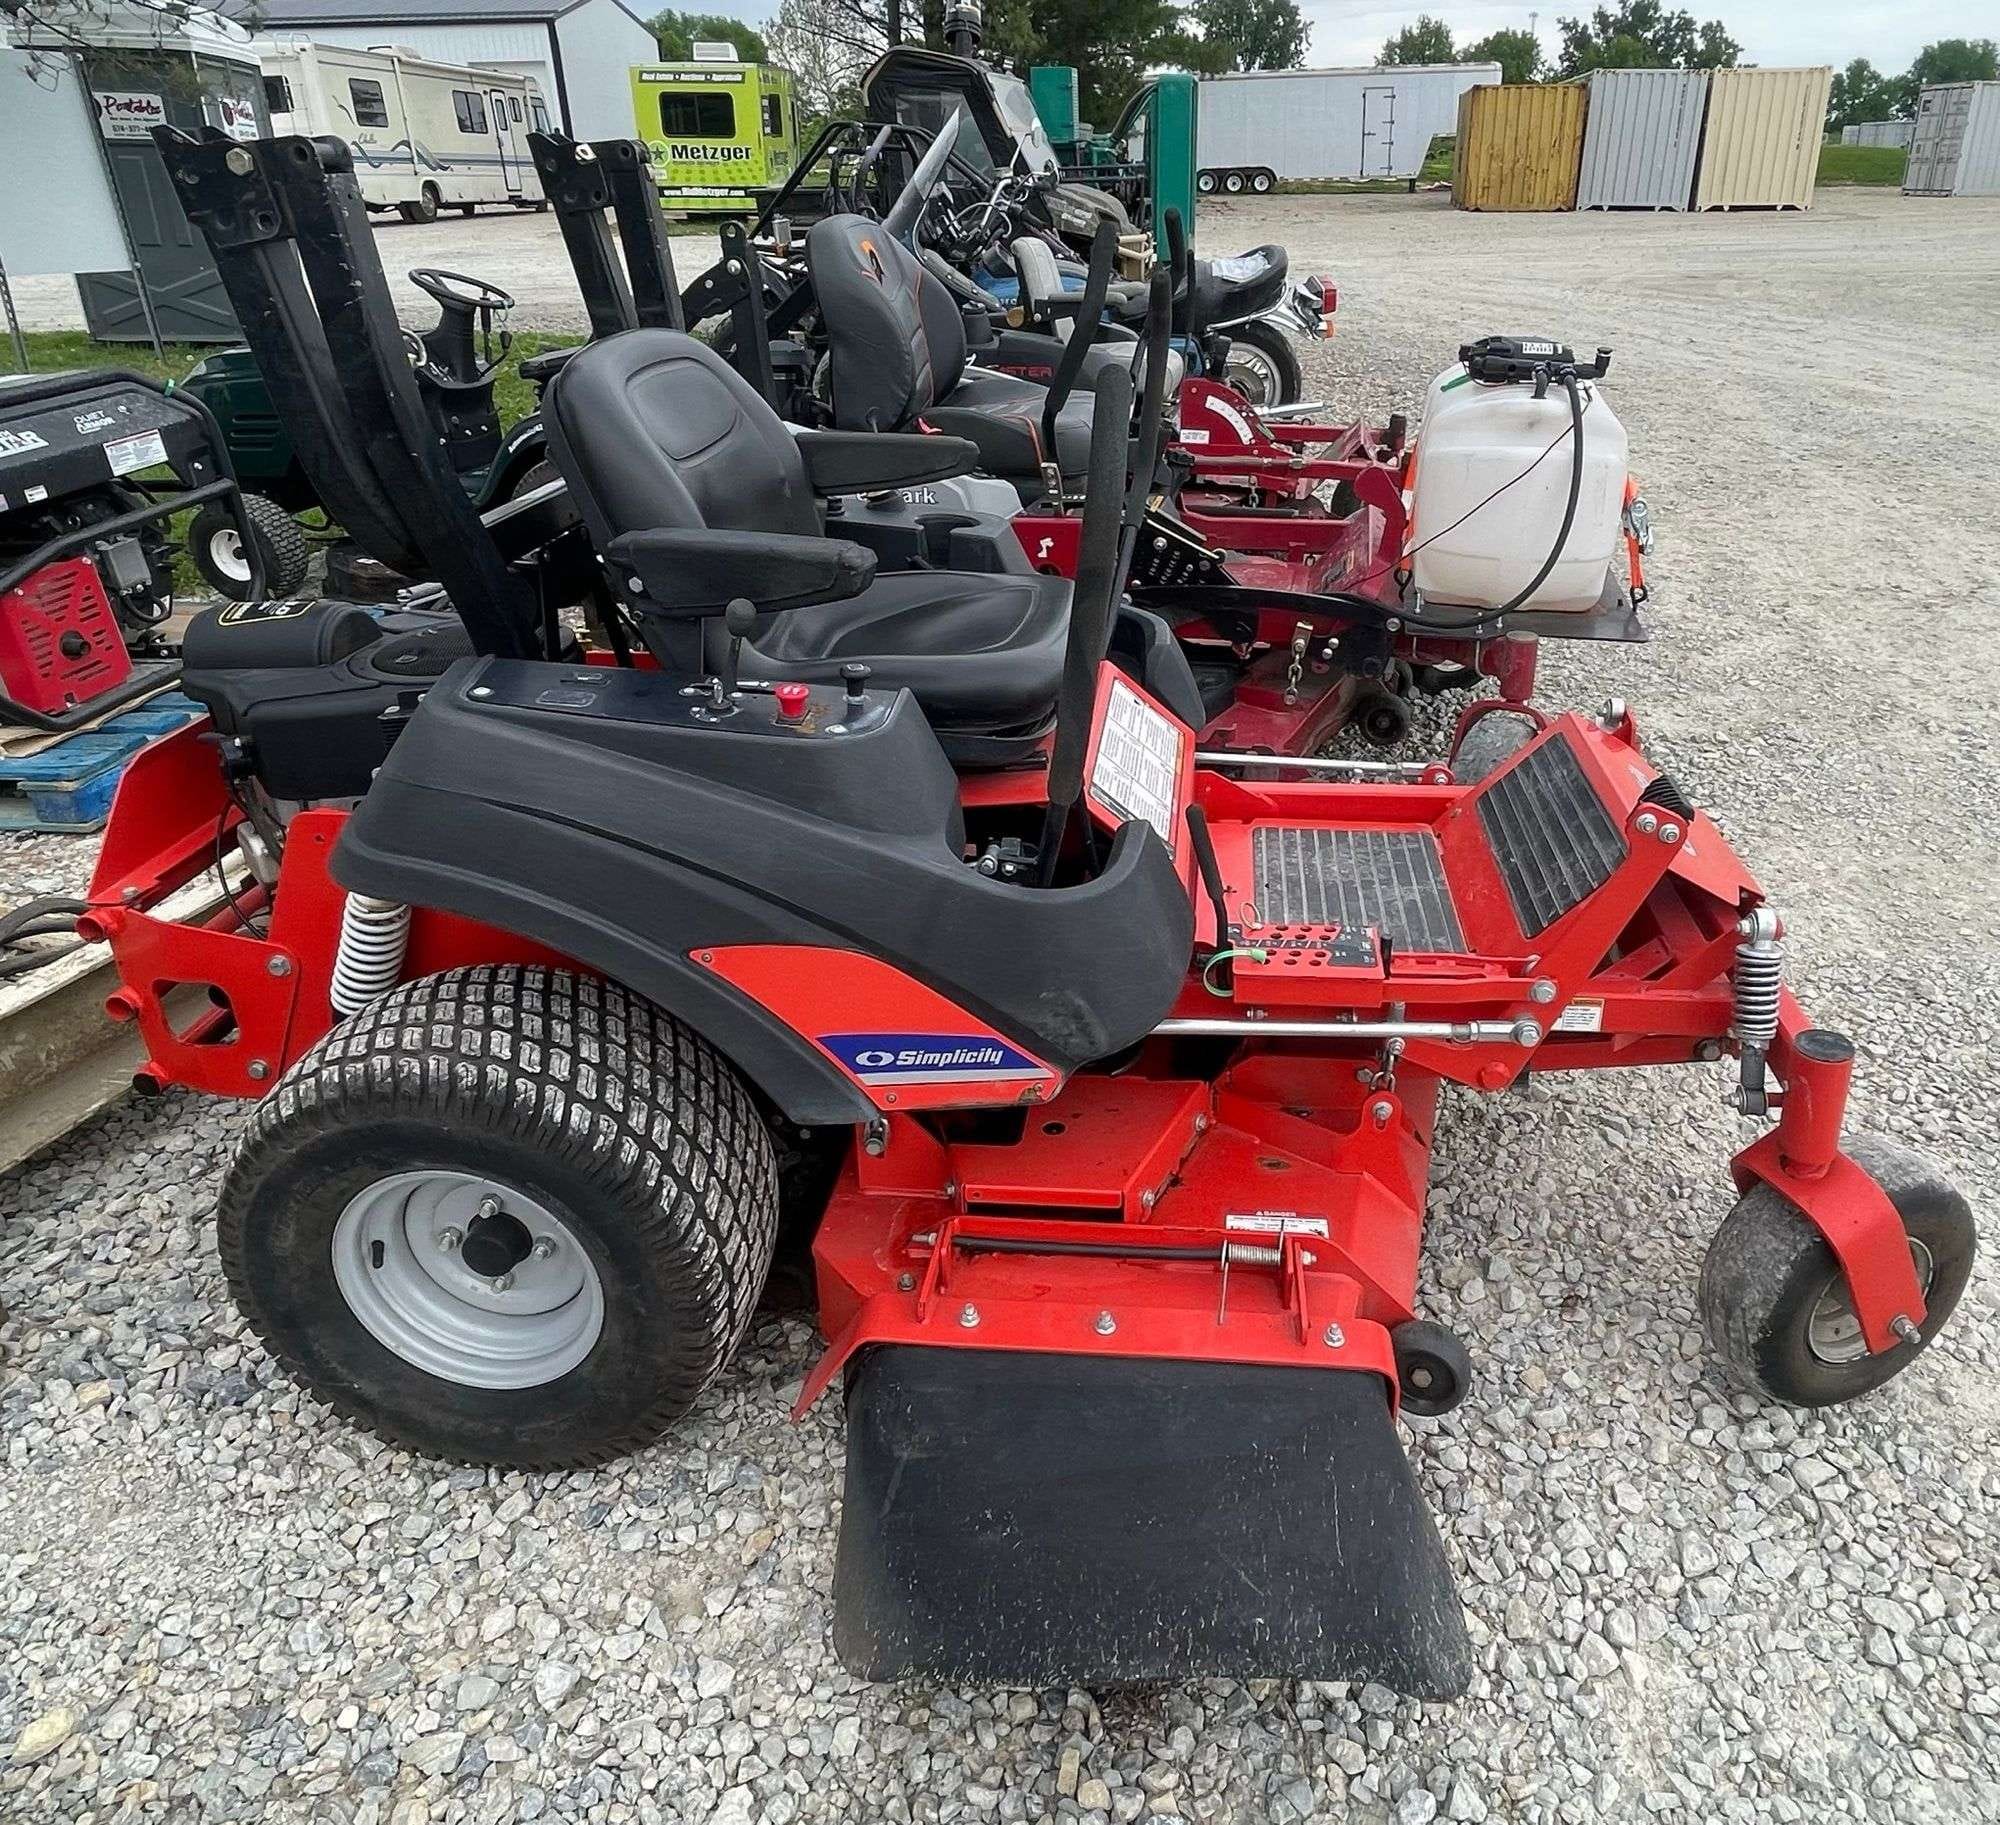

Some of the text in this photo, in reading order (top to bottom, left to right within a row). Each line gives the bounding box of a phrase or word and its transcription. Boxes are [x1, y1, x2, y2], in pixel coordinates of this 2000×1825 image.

[671, 145, 752, 160] Metzger
[73, 410, 105, 424] QUIET
[76, 417, 116, 432] ARMOR
[897, 1048, 1003, 1067] Simplicity
